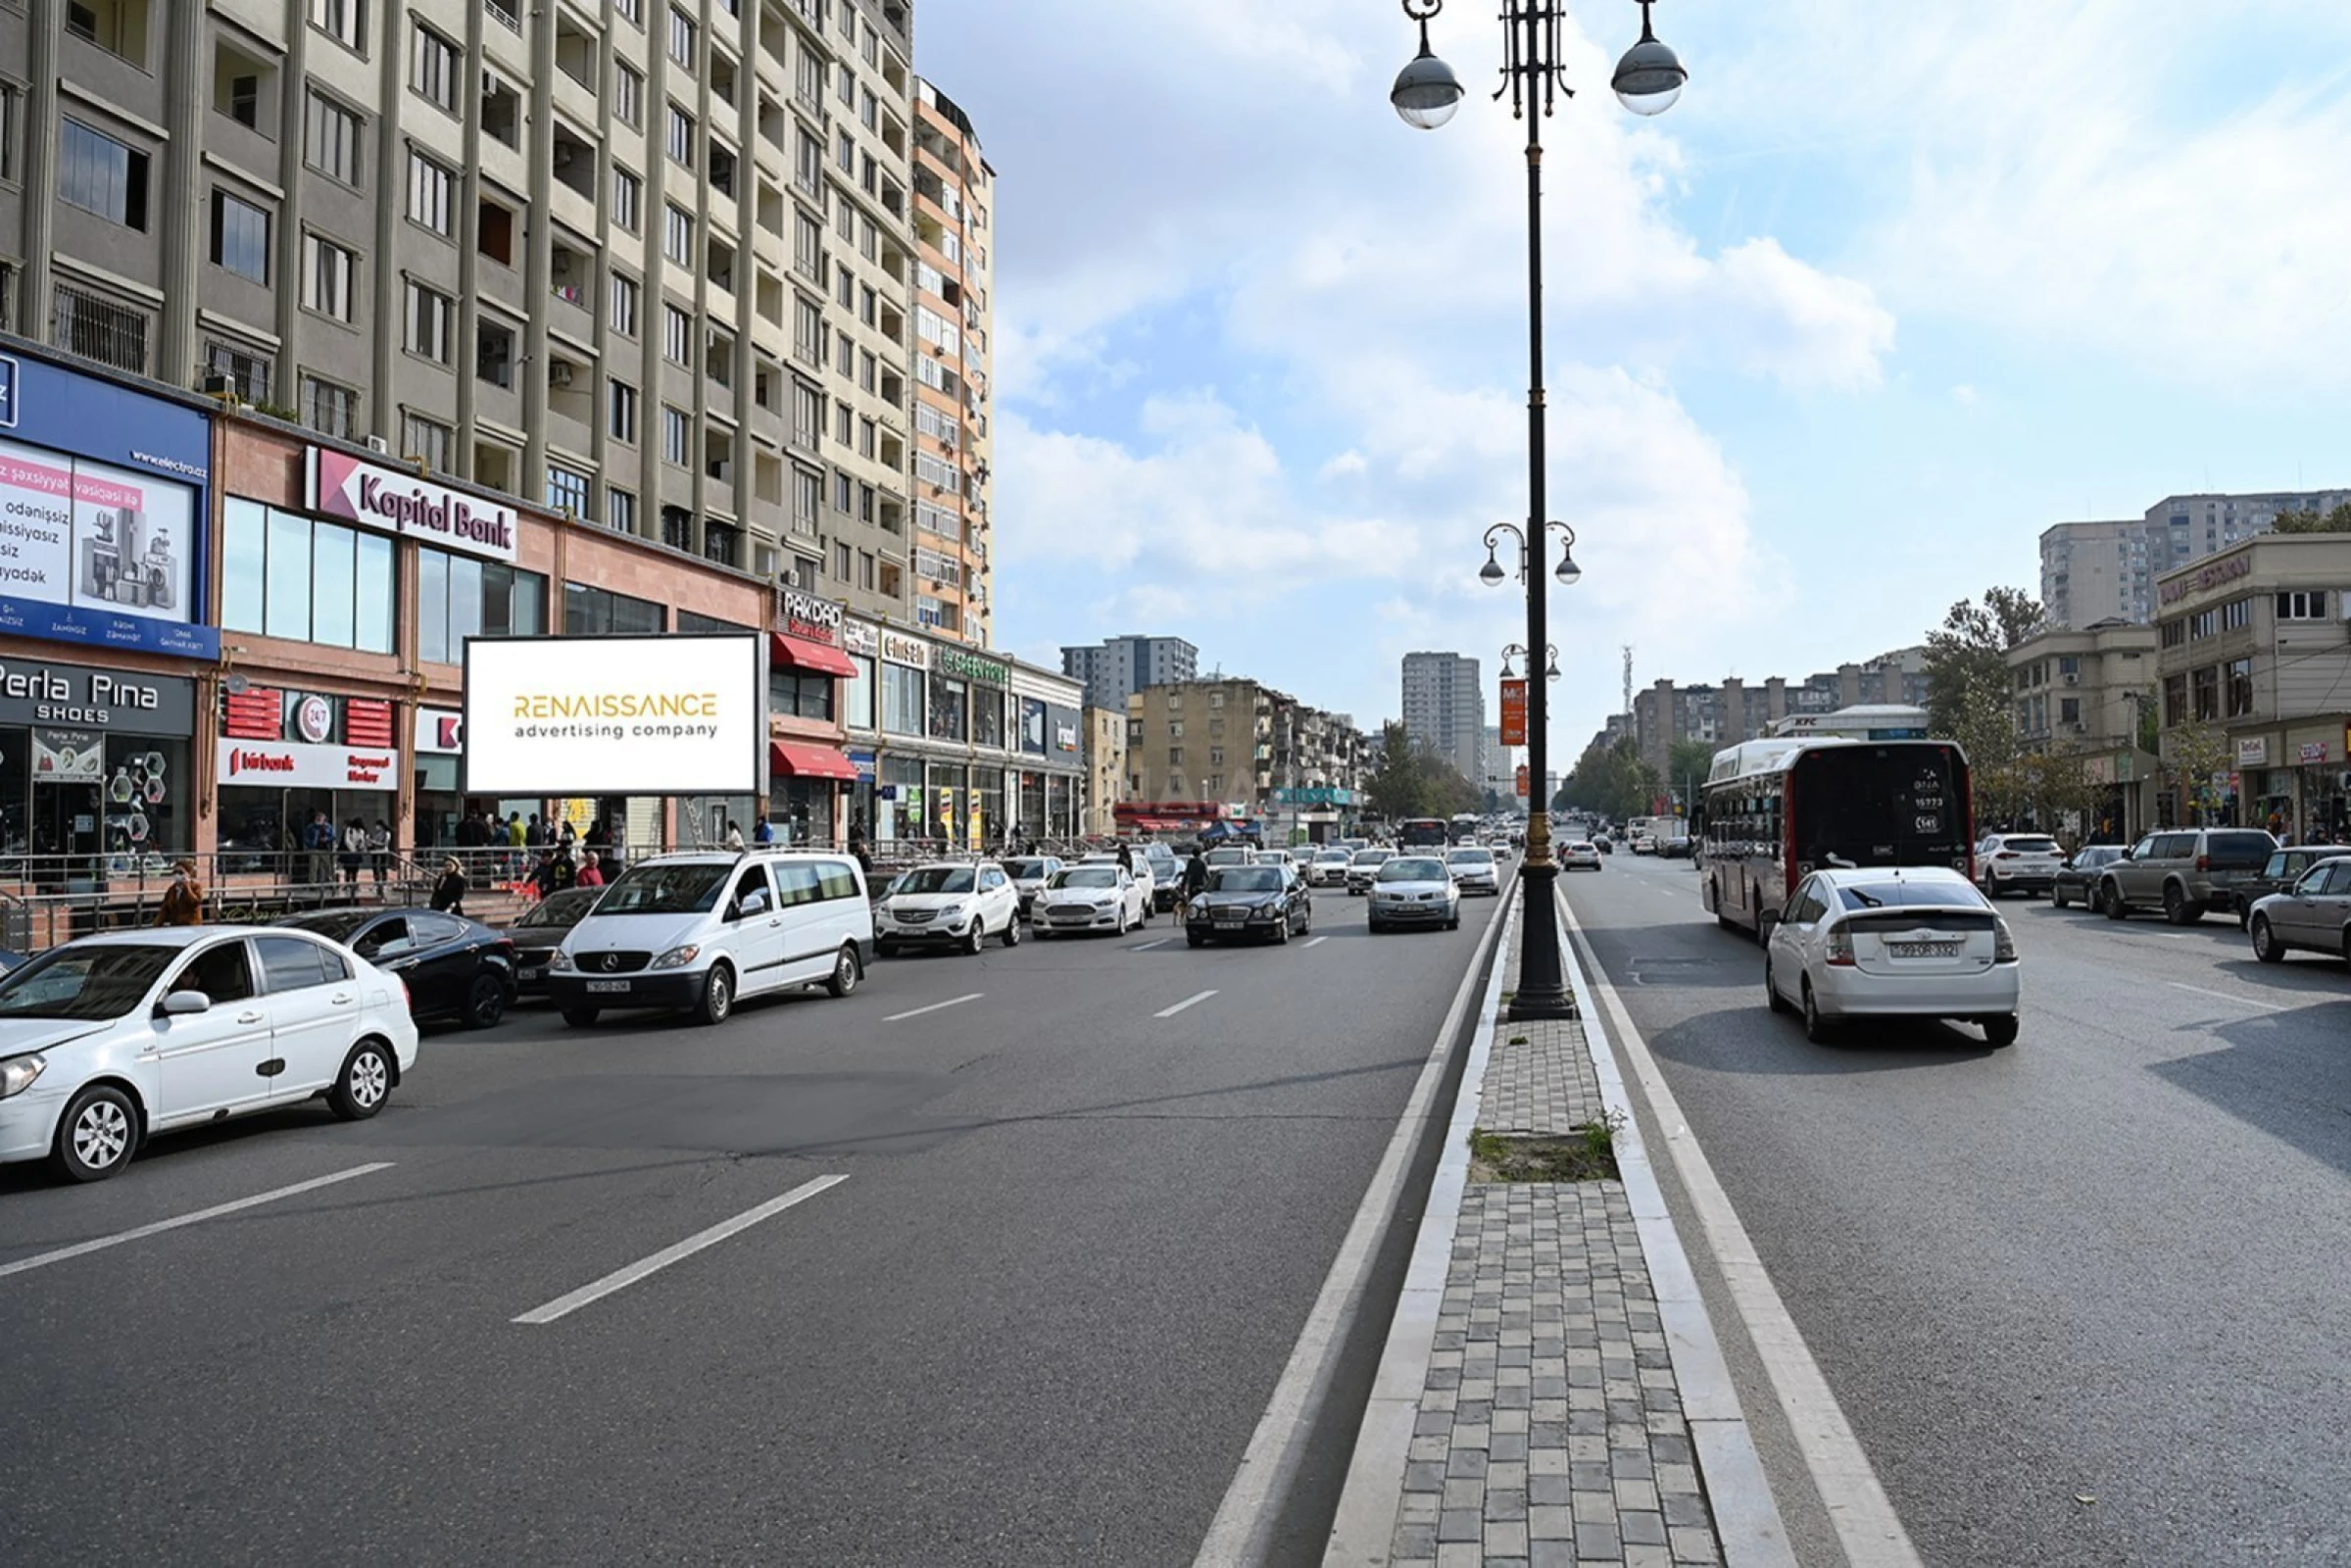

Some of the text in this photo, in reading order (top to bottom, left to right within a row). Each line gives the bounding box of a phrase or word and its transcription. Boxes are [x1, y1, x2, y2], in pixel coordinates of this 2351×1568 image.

[130, 450, 207, 478] www.electro.az
[361, 473, 512, 550] Kapital Bank
[785, 592, 842, 626] PAKDAD
[37, 705, 110, 723] SHOES
[514, 693, 717, 717] RENAISSANCE
[514, 722, 717, 740] advertising company
[1794, 717, 1817, 726] KFC
